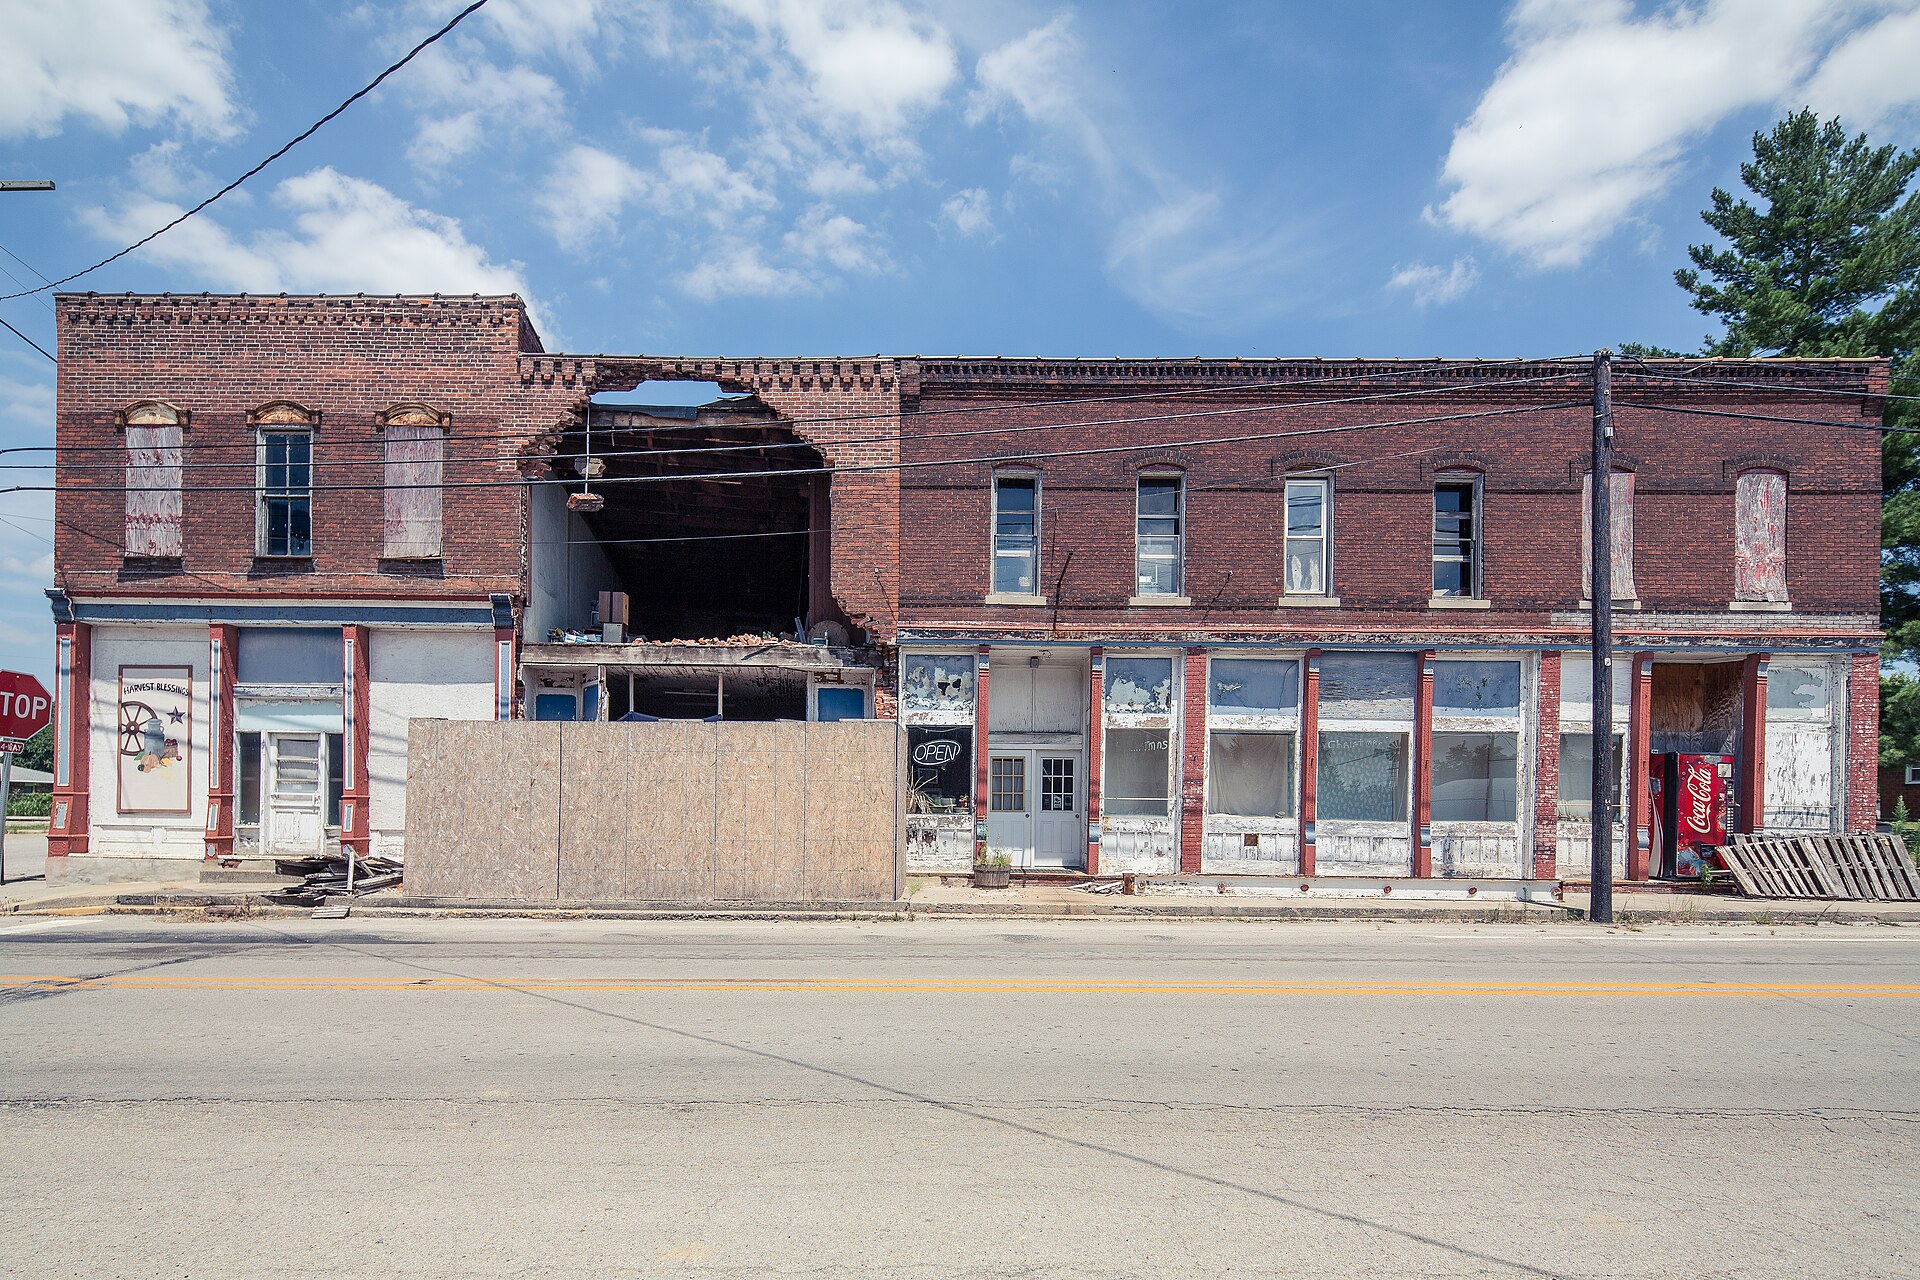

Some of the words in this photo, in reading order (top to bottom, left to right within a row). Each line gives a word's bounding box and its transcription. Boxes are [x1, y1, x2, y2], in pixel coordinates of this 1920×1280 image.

[123, 682, 154, 695] HARVEST
[156, 682, 189, 697] BLESSINGS
[0, 691, 47, 720] TOP
[0, 742, 23, 752] 4-WAY
[914, 743, 957, 761] OPEN
[1686, 761, 1712, 834] Coca-Cola
